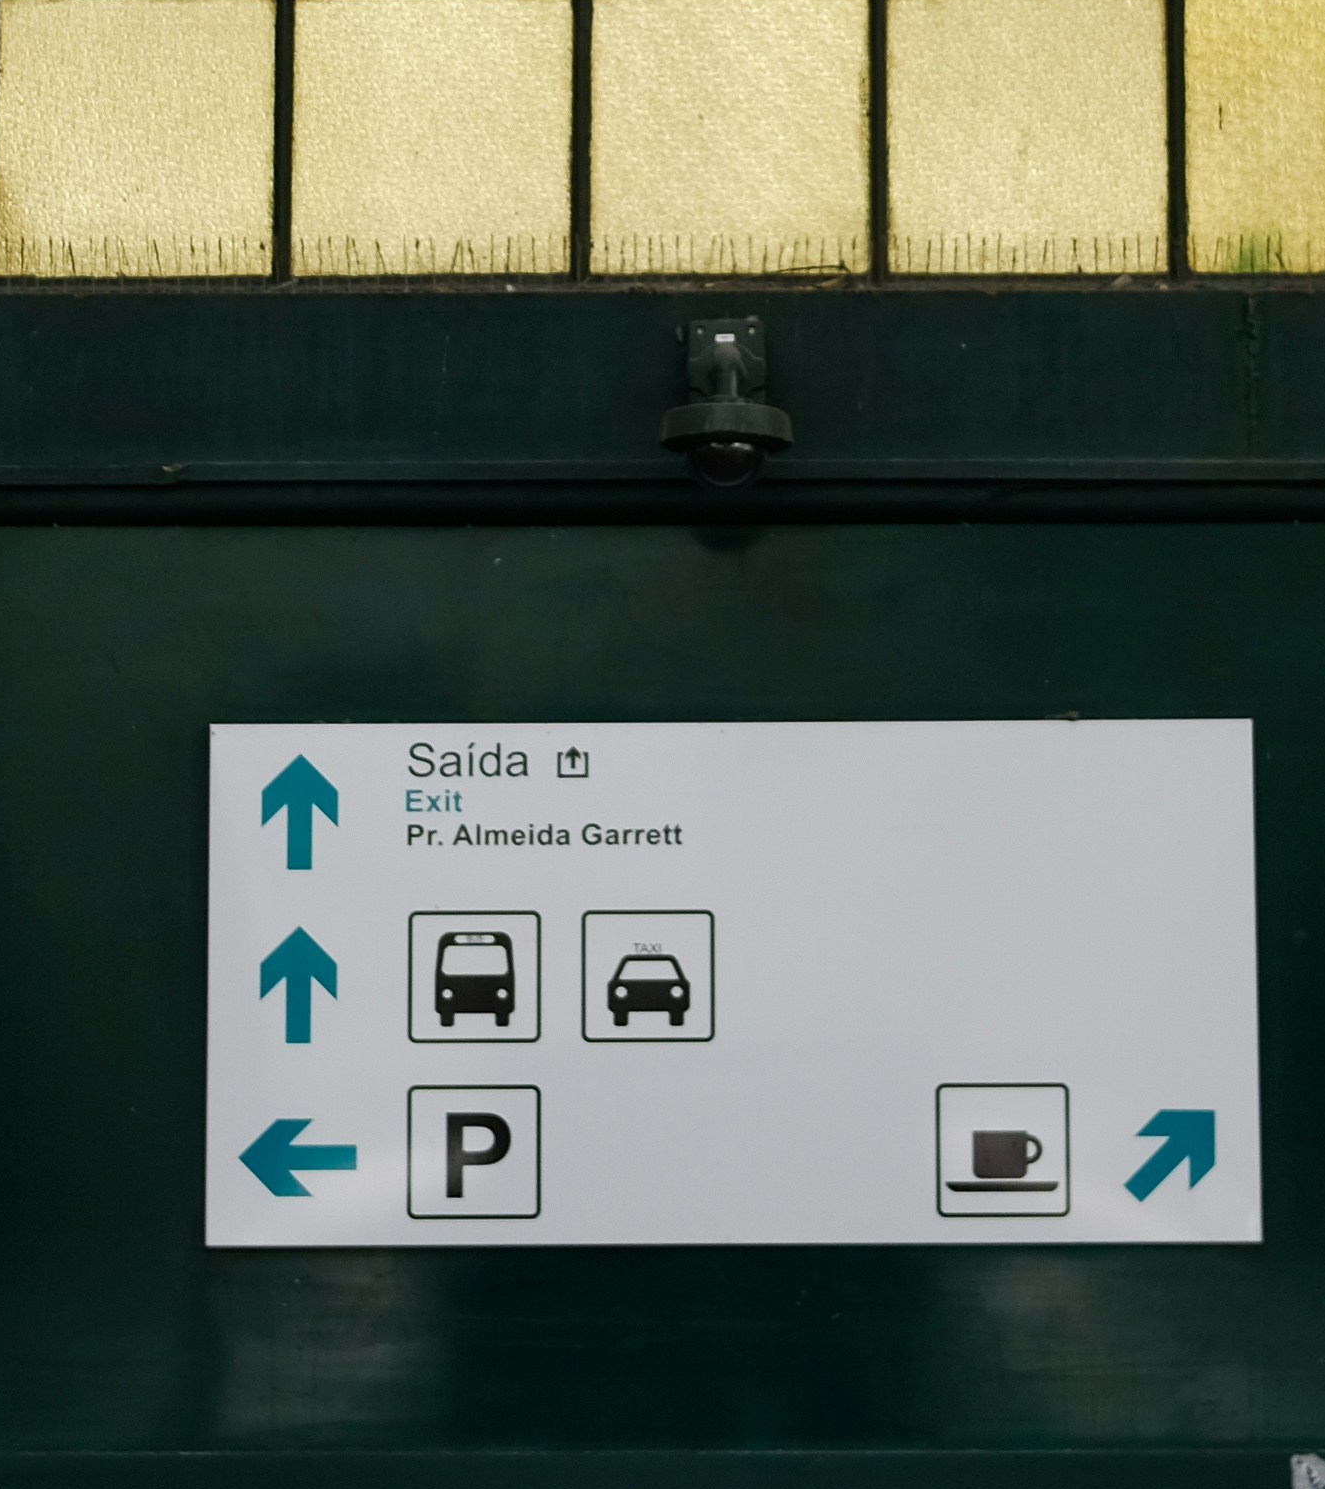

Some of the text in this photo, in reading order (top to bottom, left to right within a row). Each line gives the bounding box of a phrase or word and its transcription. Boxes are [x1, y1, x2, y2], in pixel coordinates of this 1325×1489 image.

[408, 743, 528, 777] Saída
[406, 790, 462, 812] Exit
[408, 823, 682, 846] Pr. Almeida Garrett
[634, 943, 662, 953] TAXI
[446, 1113, 511, 1198] P
